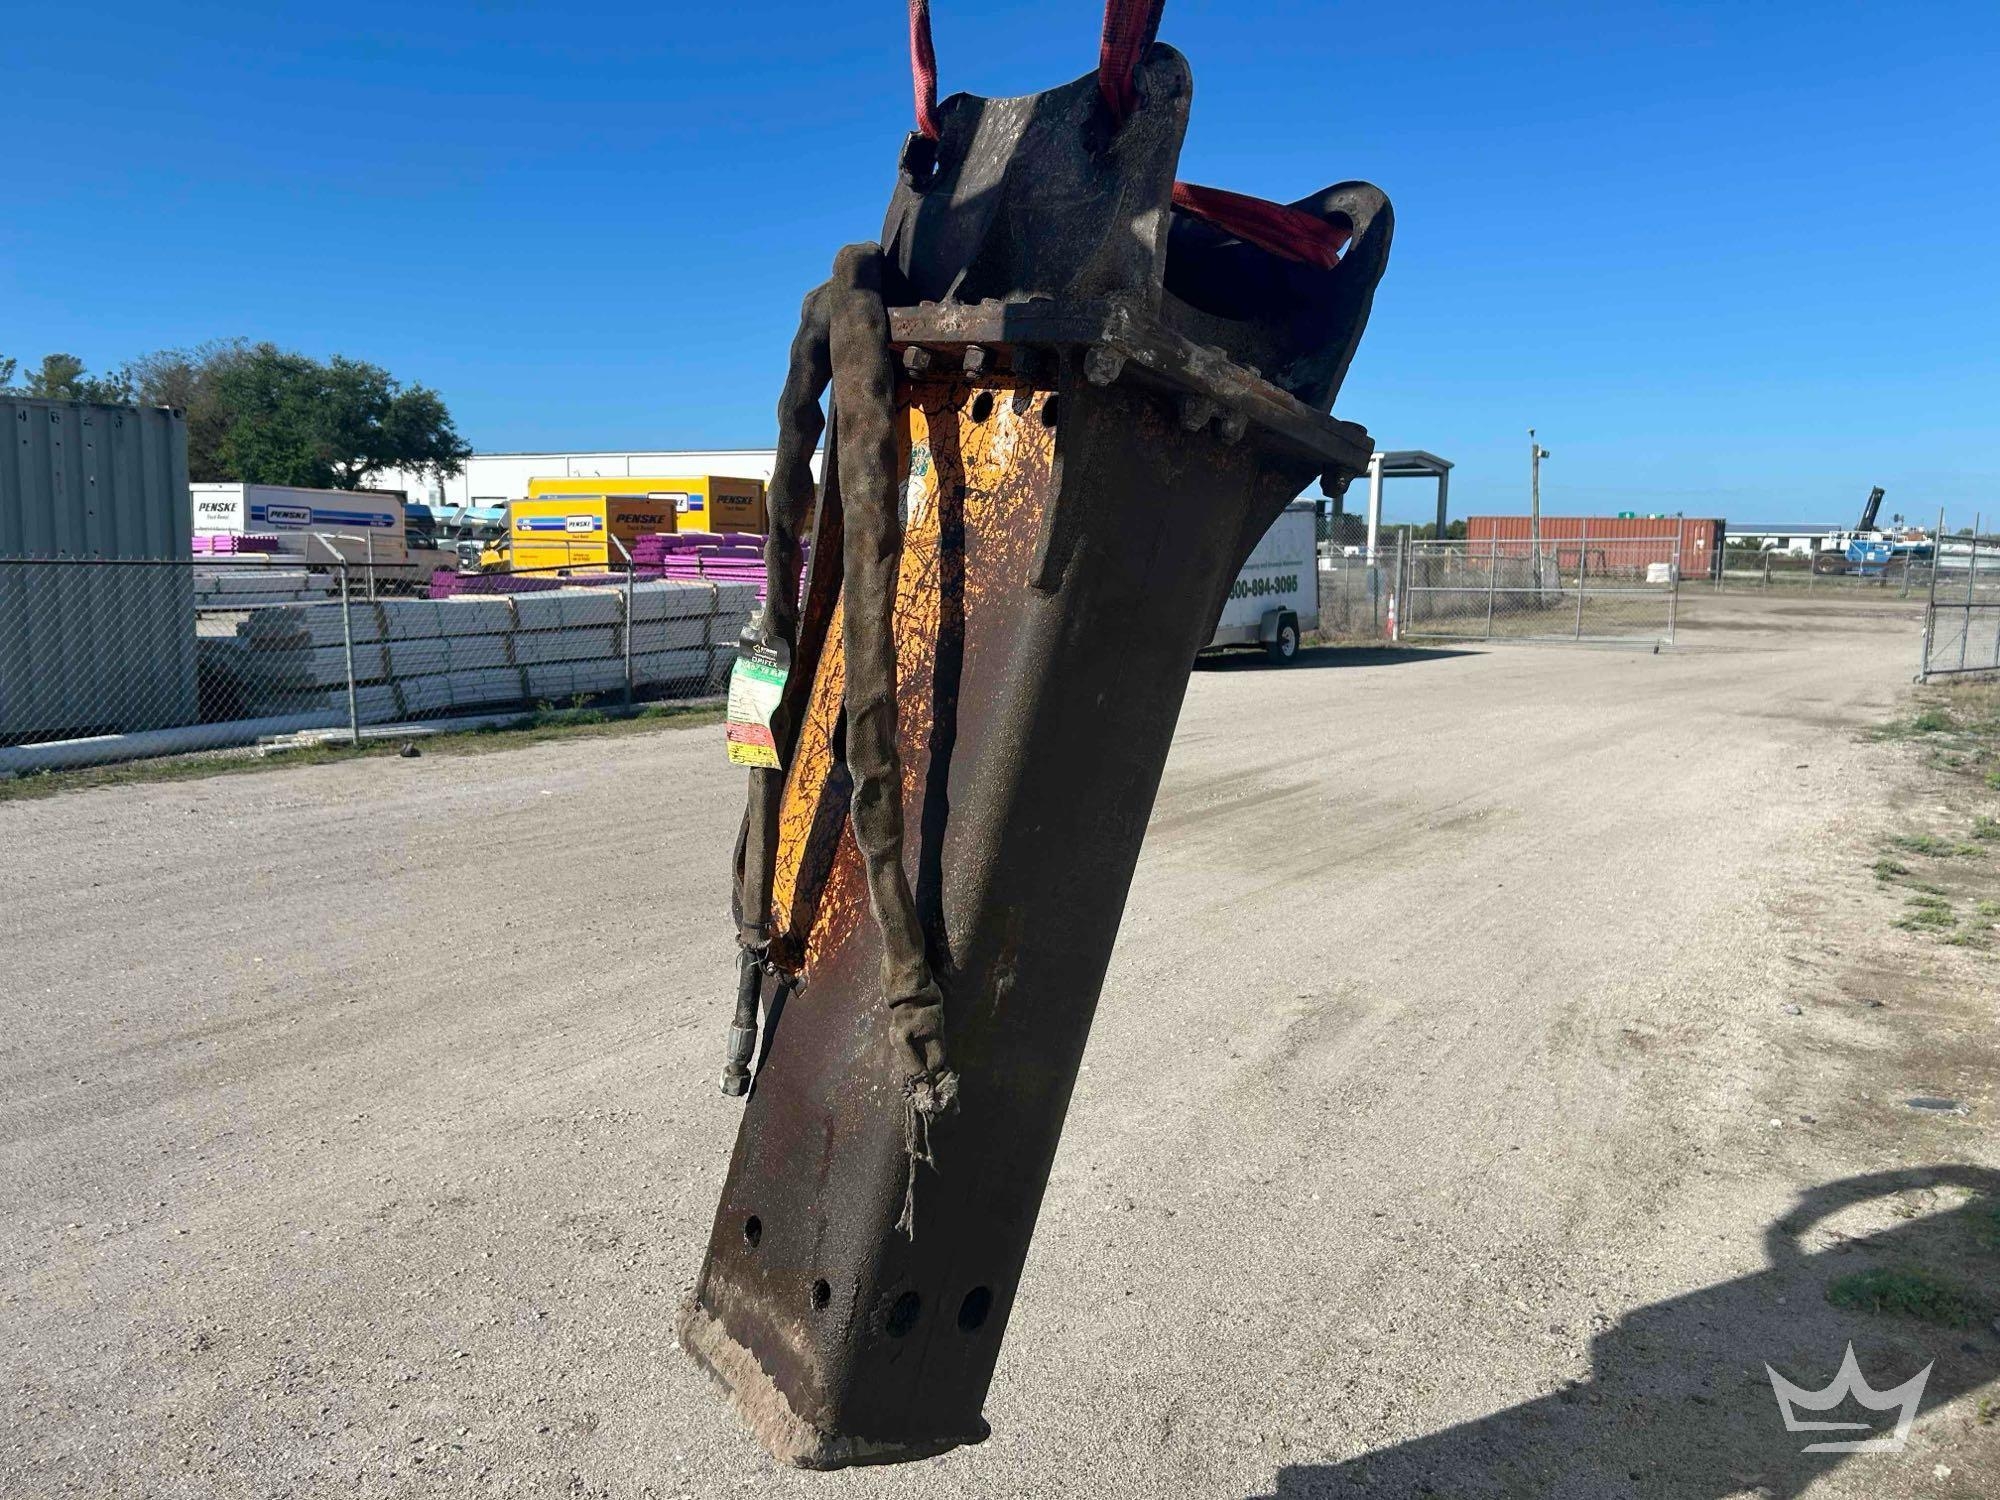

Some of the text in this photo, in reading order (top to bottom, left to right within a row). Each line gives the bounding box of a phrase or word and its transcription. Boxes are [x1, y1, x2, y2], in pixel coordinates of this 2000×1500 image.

[716, 495, 753, 505] PENSKE
[198, 502, 238, 512] PENSKE
[270, 510, 308, 519] PENSKE
[615, 513, 666, 524] PENSKE
[568, 520, 591, 528] PENSKE
